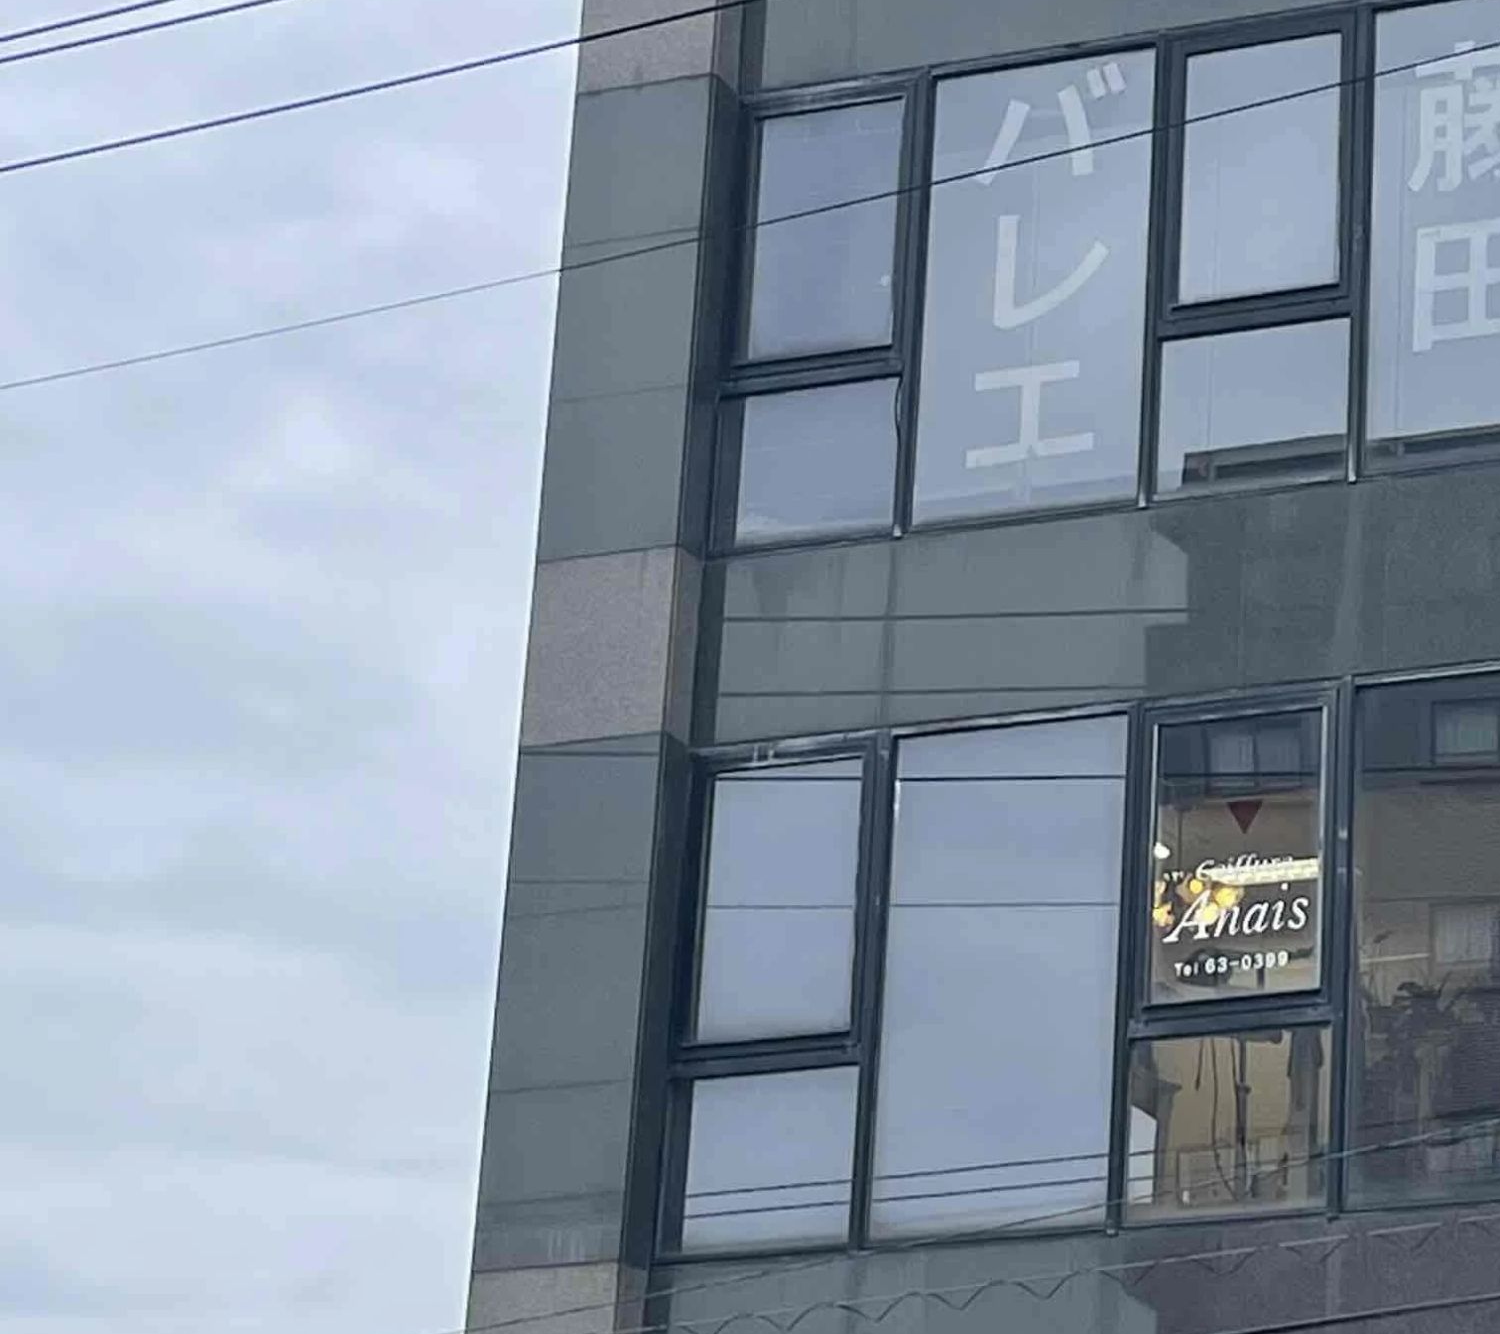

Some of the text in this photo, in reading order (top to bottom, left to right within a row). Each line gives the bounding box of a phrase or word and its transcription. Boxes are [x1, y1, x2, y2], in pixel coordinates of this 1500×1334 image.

[965, 62, 1128, 469] バレエ
[1162, 882, 1309, 943] Anais
